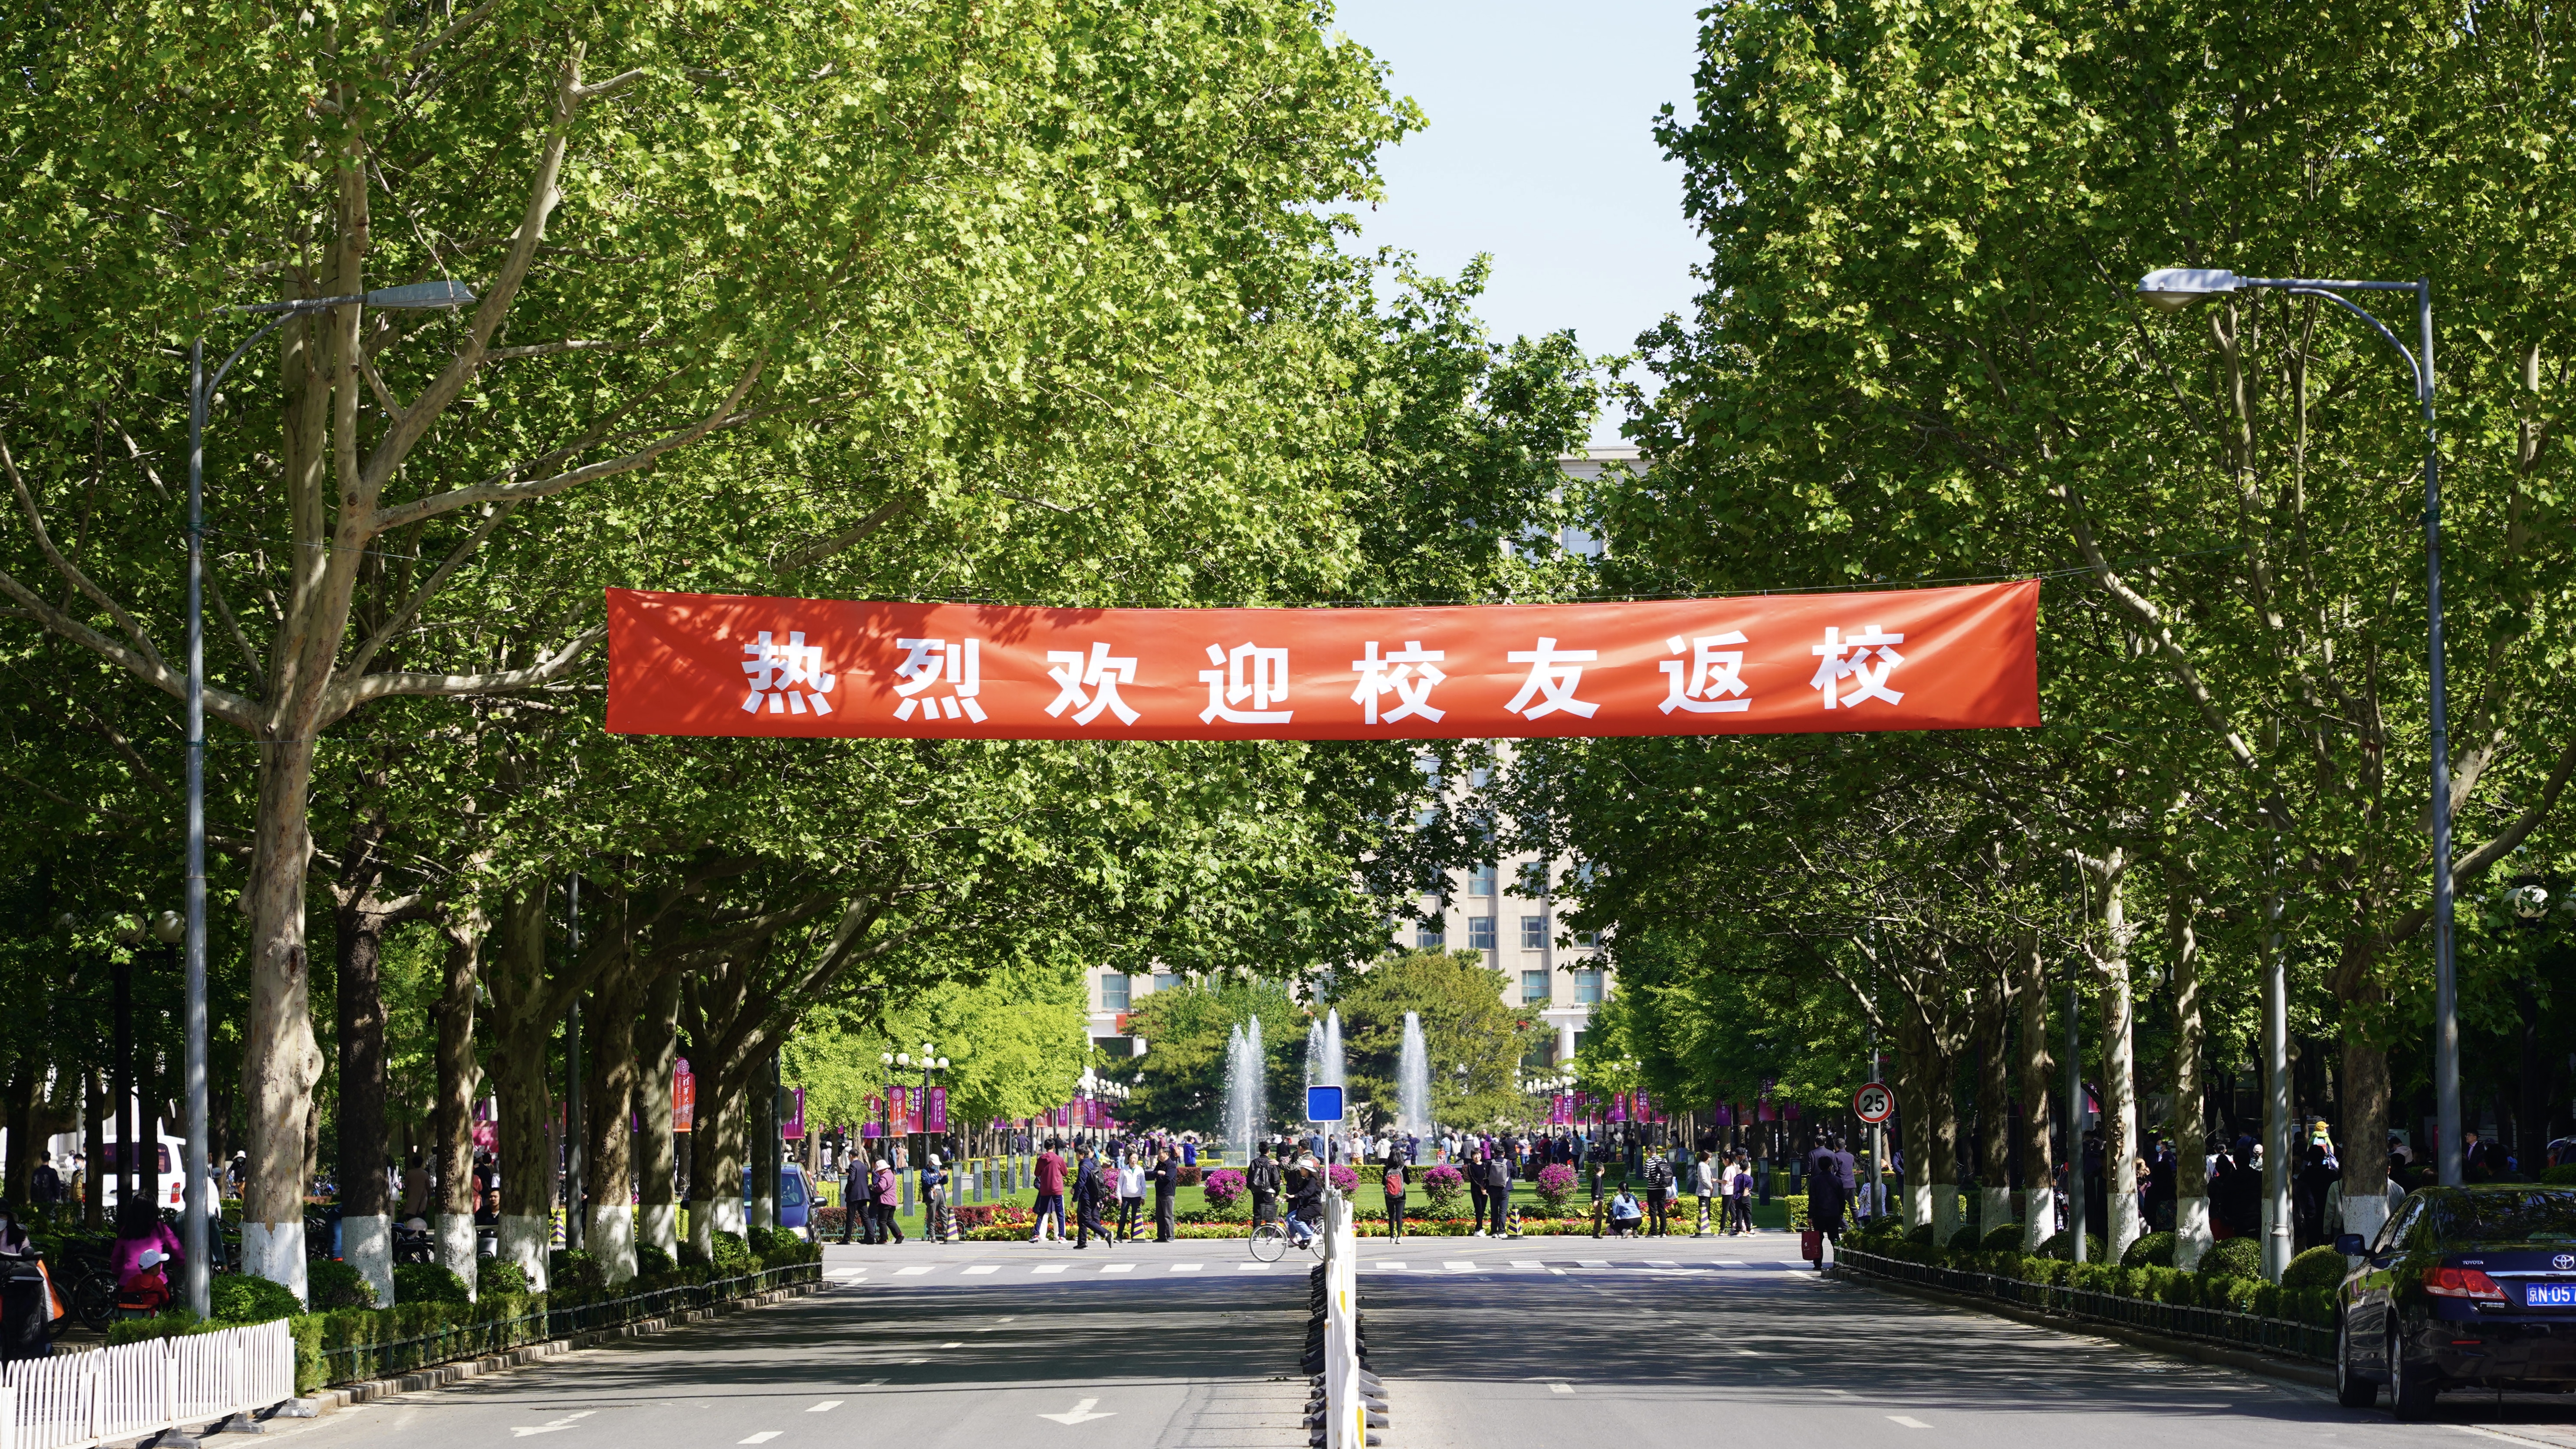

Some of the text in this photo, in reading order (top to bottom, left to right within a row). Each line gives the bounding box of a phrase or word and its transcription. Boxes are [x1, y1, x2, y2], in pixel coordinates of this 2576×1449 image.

[741, 625, 1905, 726] 热烈欢迎校友返校
[1863, 1095, 1885, 1112] 25
